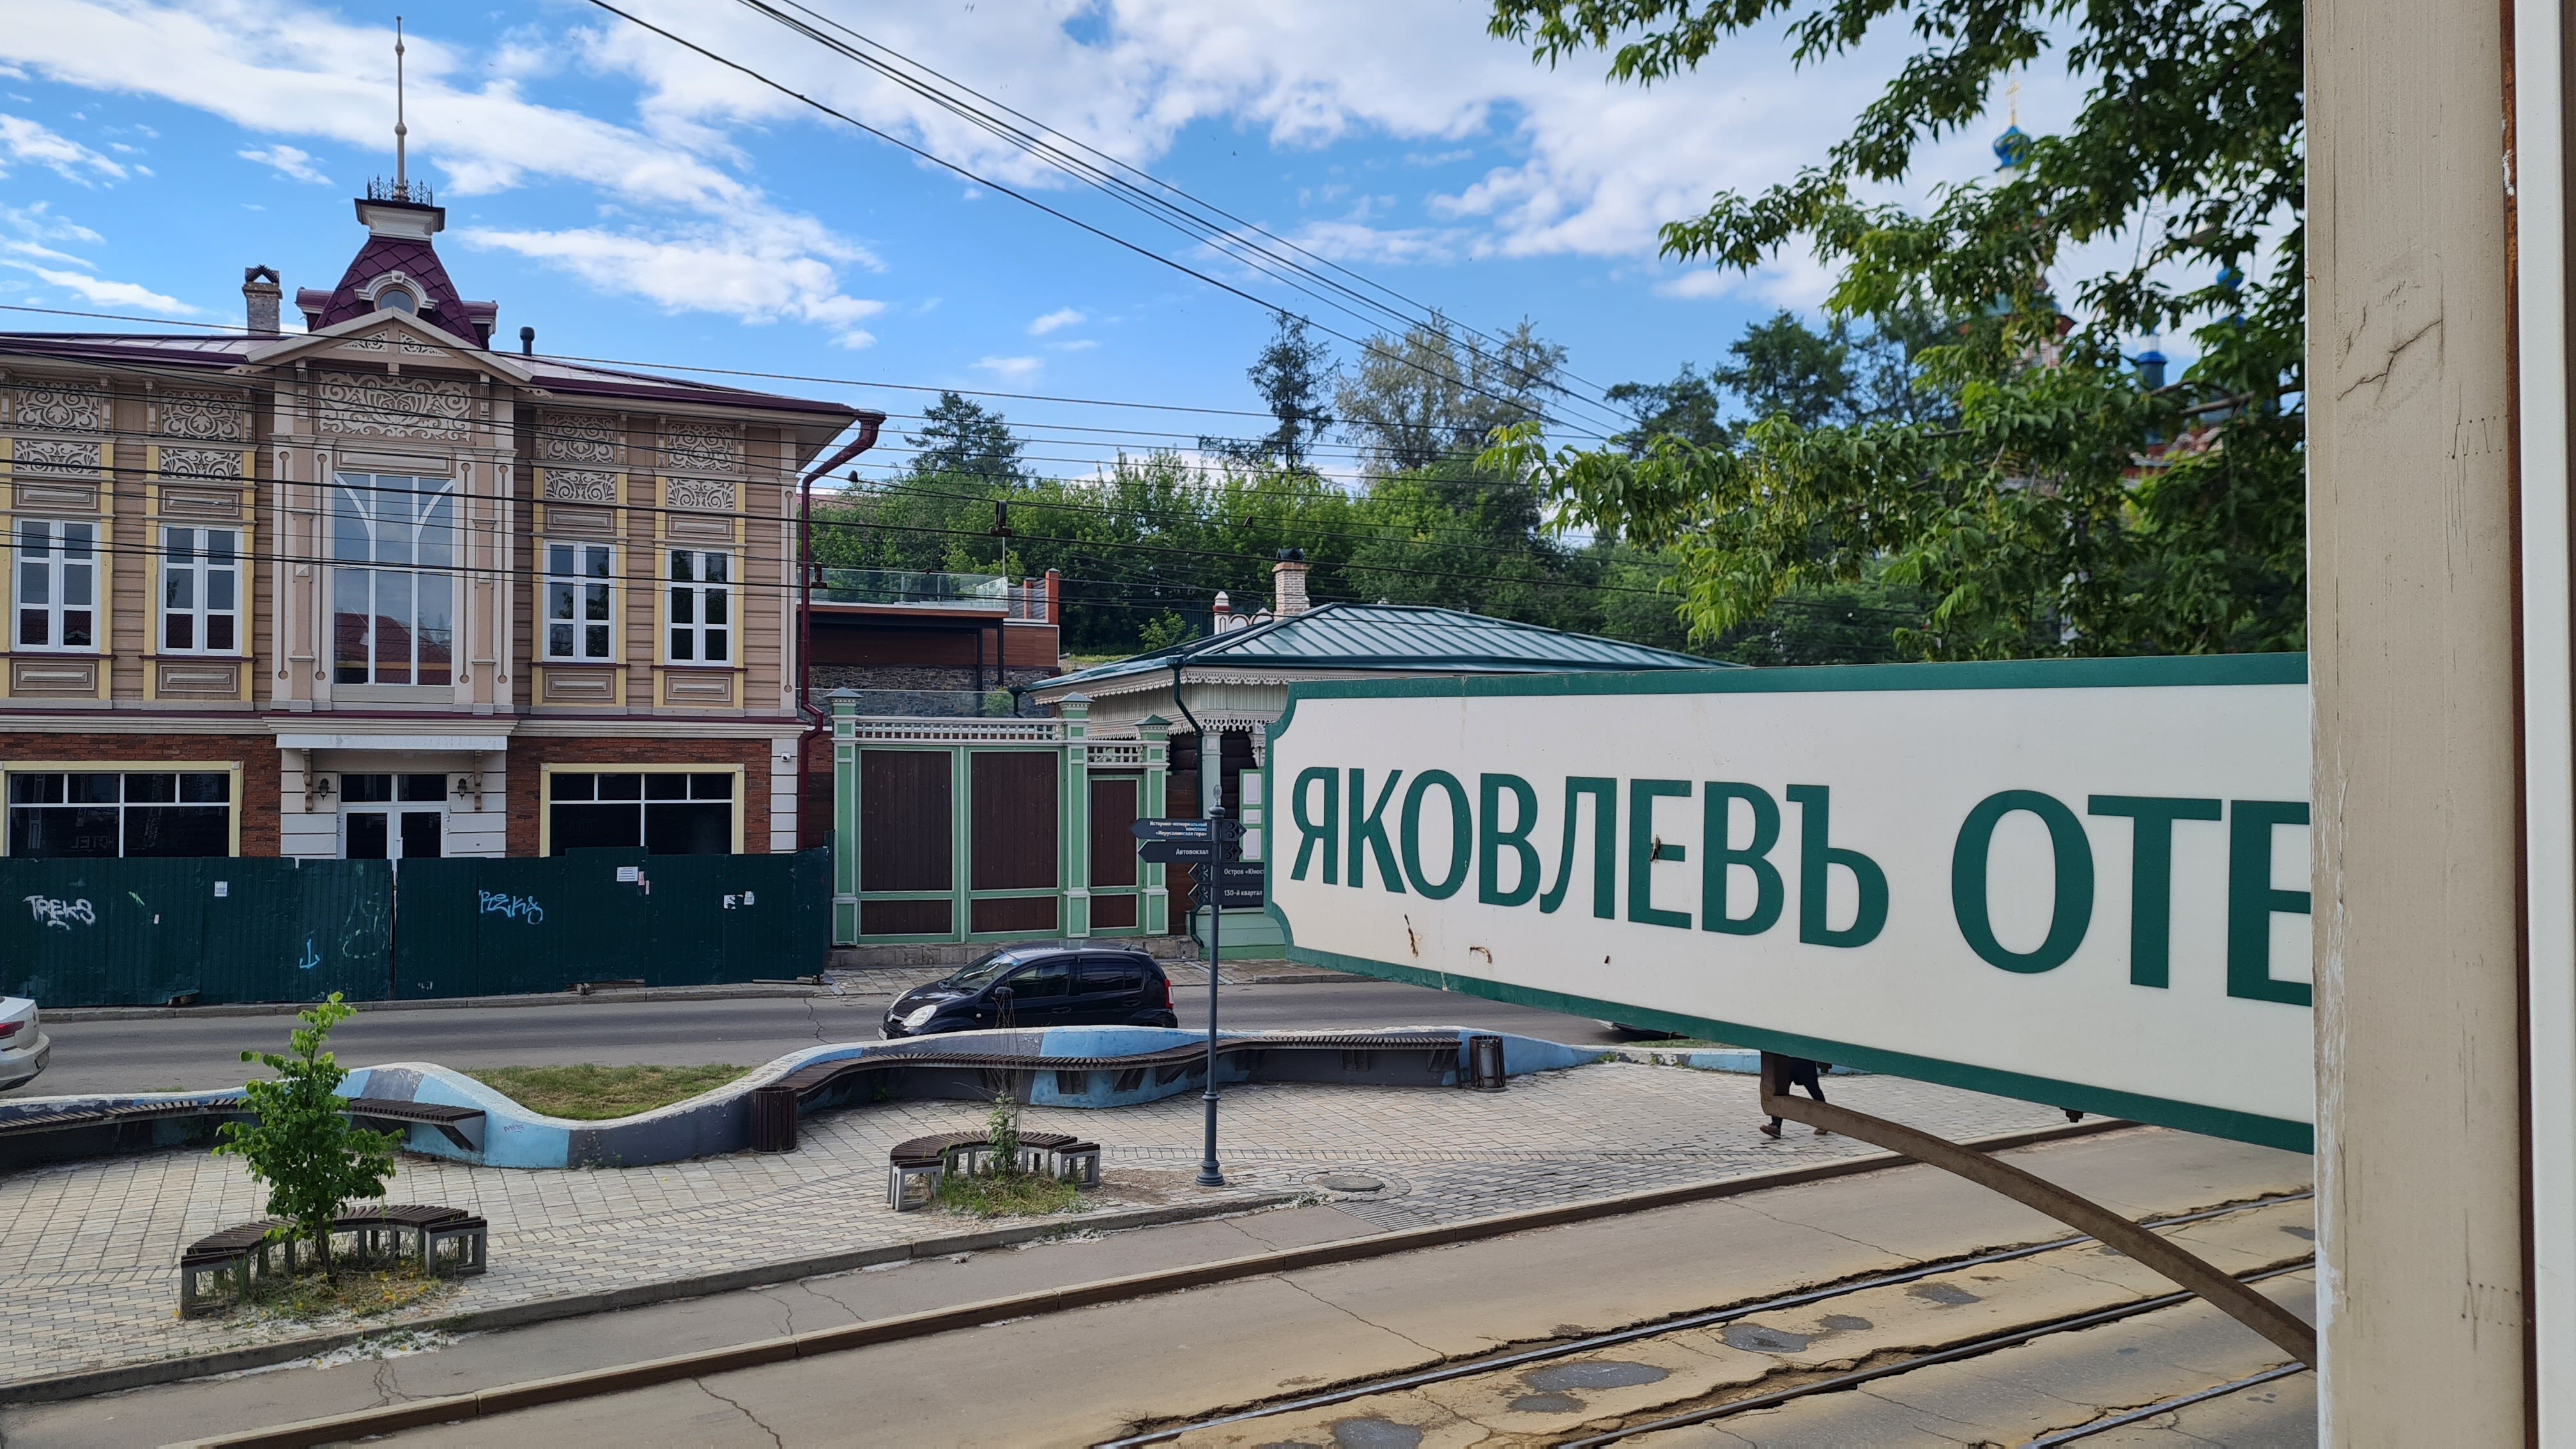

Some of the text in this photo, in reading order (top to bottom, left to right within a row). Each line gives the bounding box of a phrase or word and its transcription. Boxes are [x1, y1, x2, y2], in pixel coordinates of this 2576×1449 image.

[1223, 868, 1244, 877] Остров
[1291, 767, 2312, 1007] ЯКОВЛЕВЪ ОТЕ
